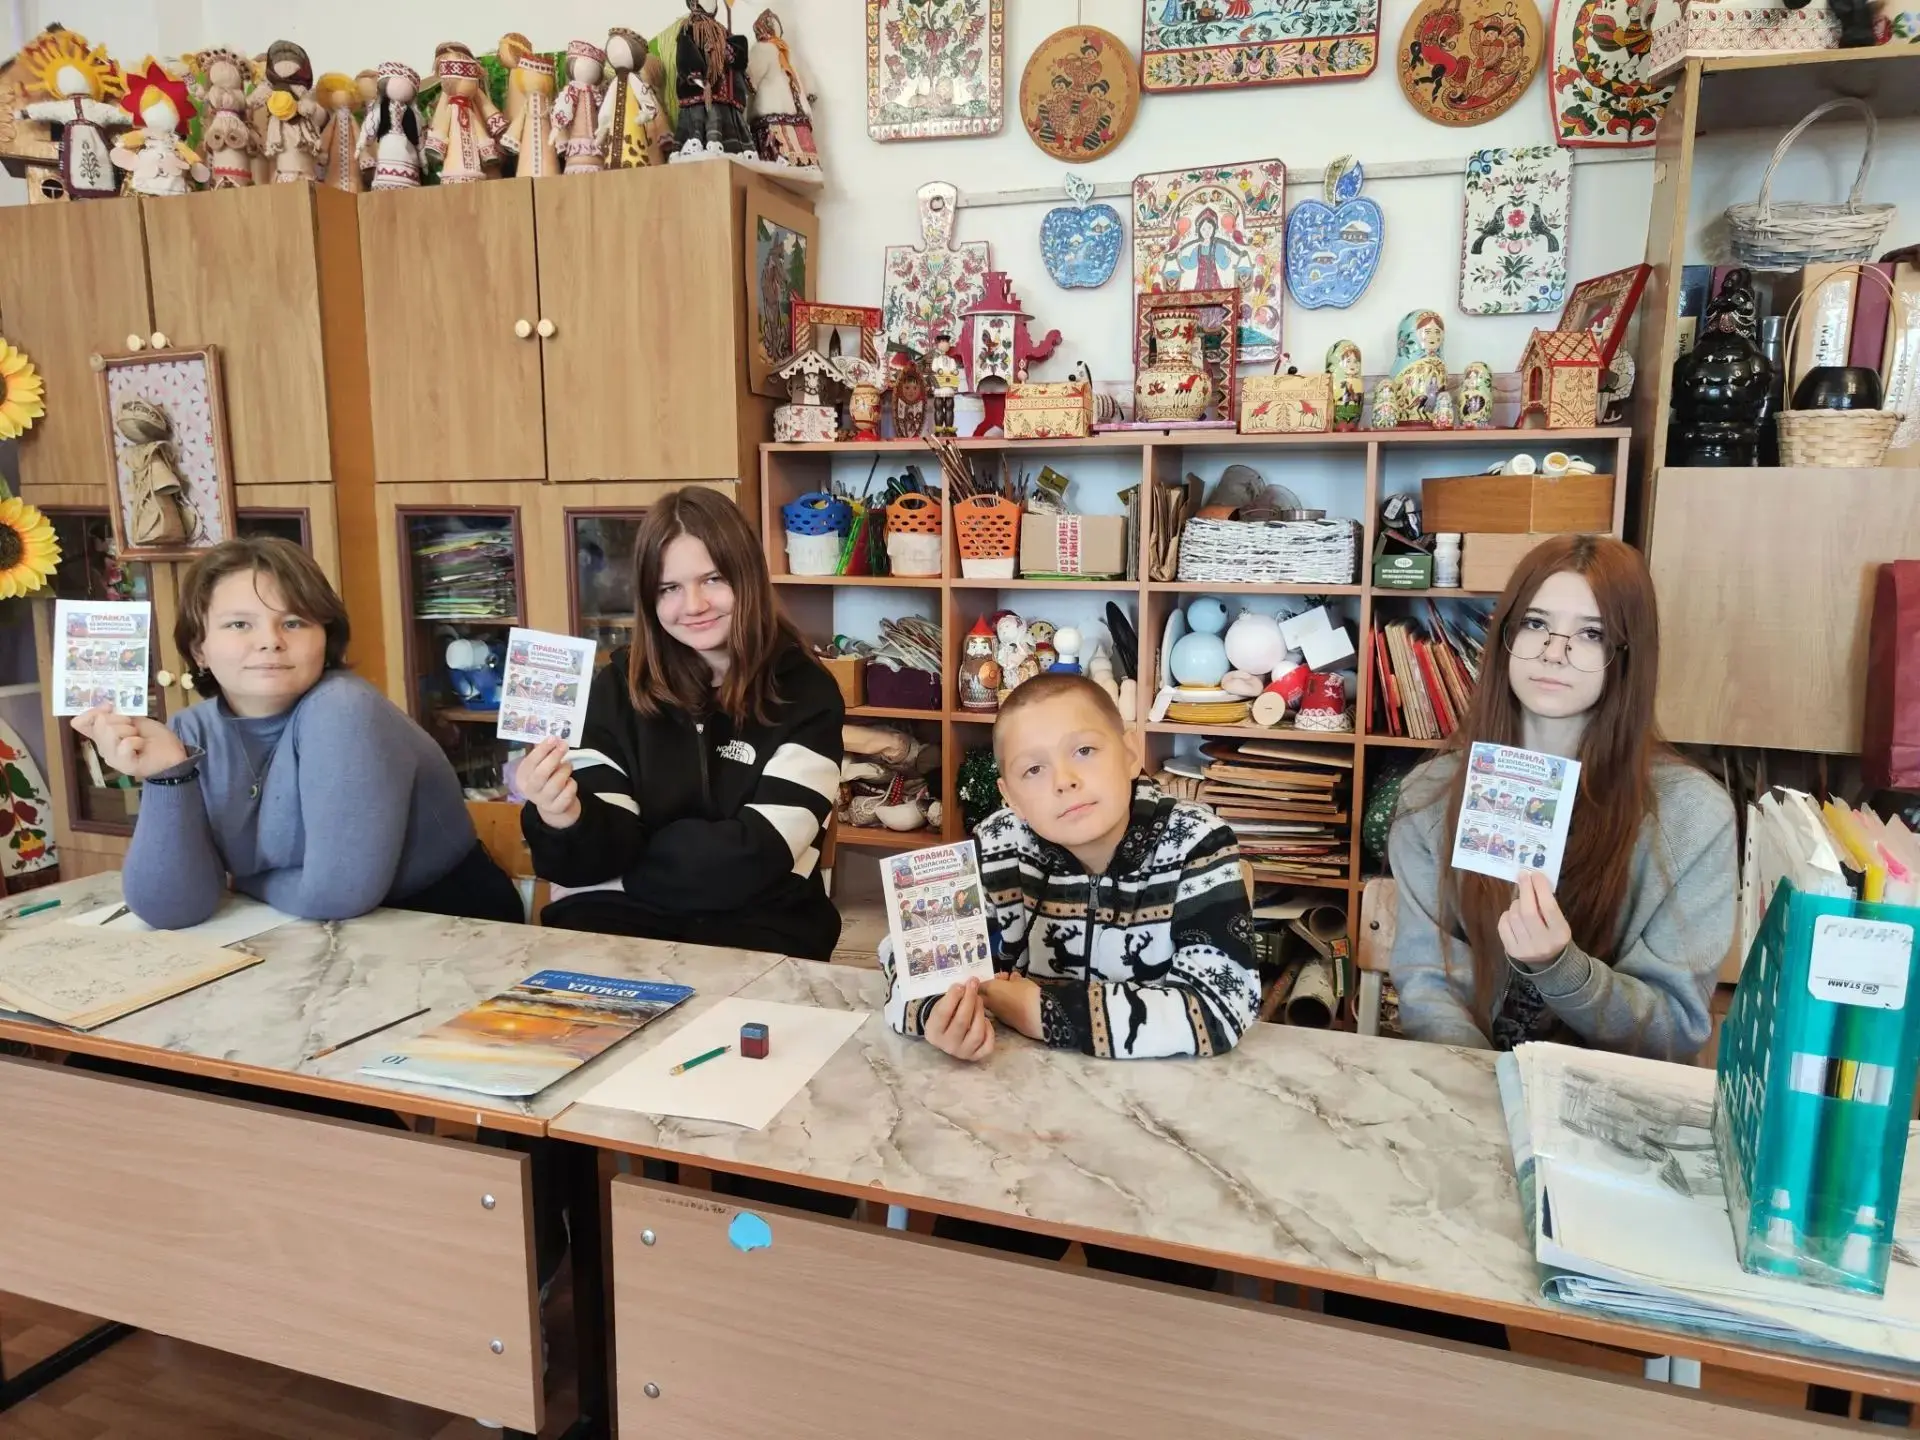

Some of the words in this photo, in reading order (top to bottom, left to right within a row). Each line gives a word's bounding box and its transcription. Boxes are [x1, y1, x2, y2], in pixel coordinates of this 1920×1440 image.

[729, 739, 745, 748] THE
[715, 745, 742, 755] NORTH
[720, 751, 741, 761] FACE
[1500, 749, 1545, 766] ПРАВИЛА
[1497, 757, 1546, 773] БЕЗОПАСНОСТИ
[914, 848, 955, 864] ПРАВИЛА
[913, 857, 958, 871] БЕЗОПАСНОСТИ
[567, 982, 640, 998] БУМАГА
[1827, 979, 1862, 990] STAMM
[381, 1056, 409, 1065] 10
